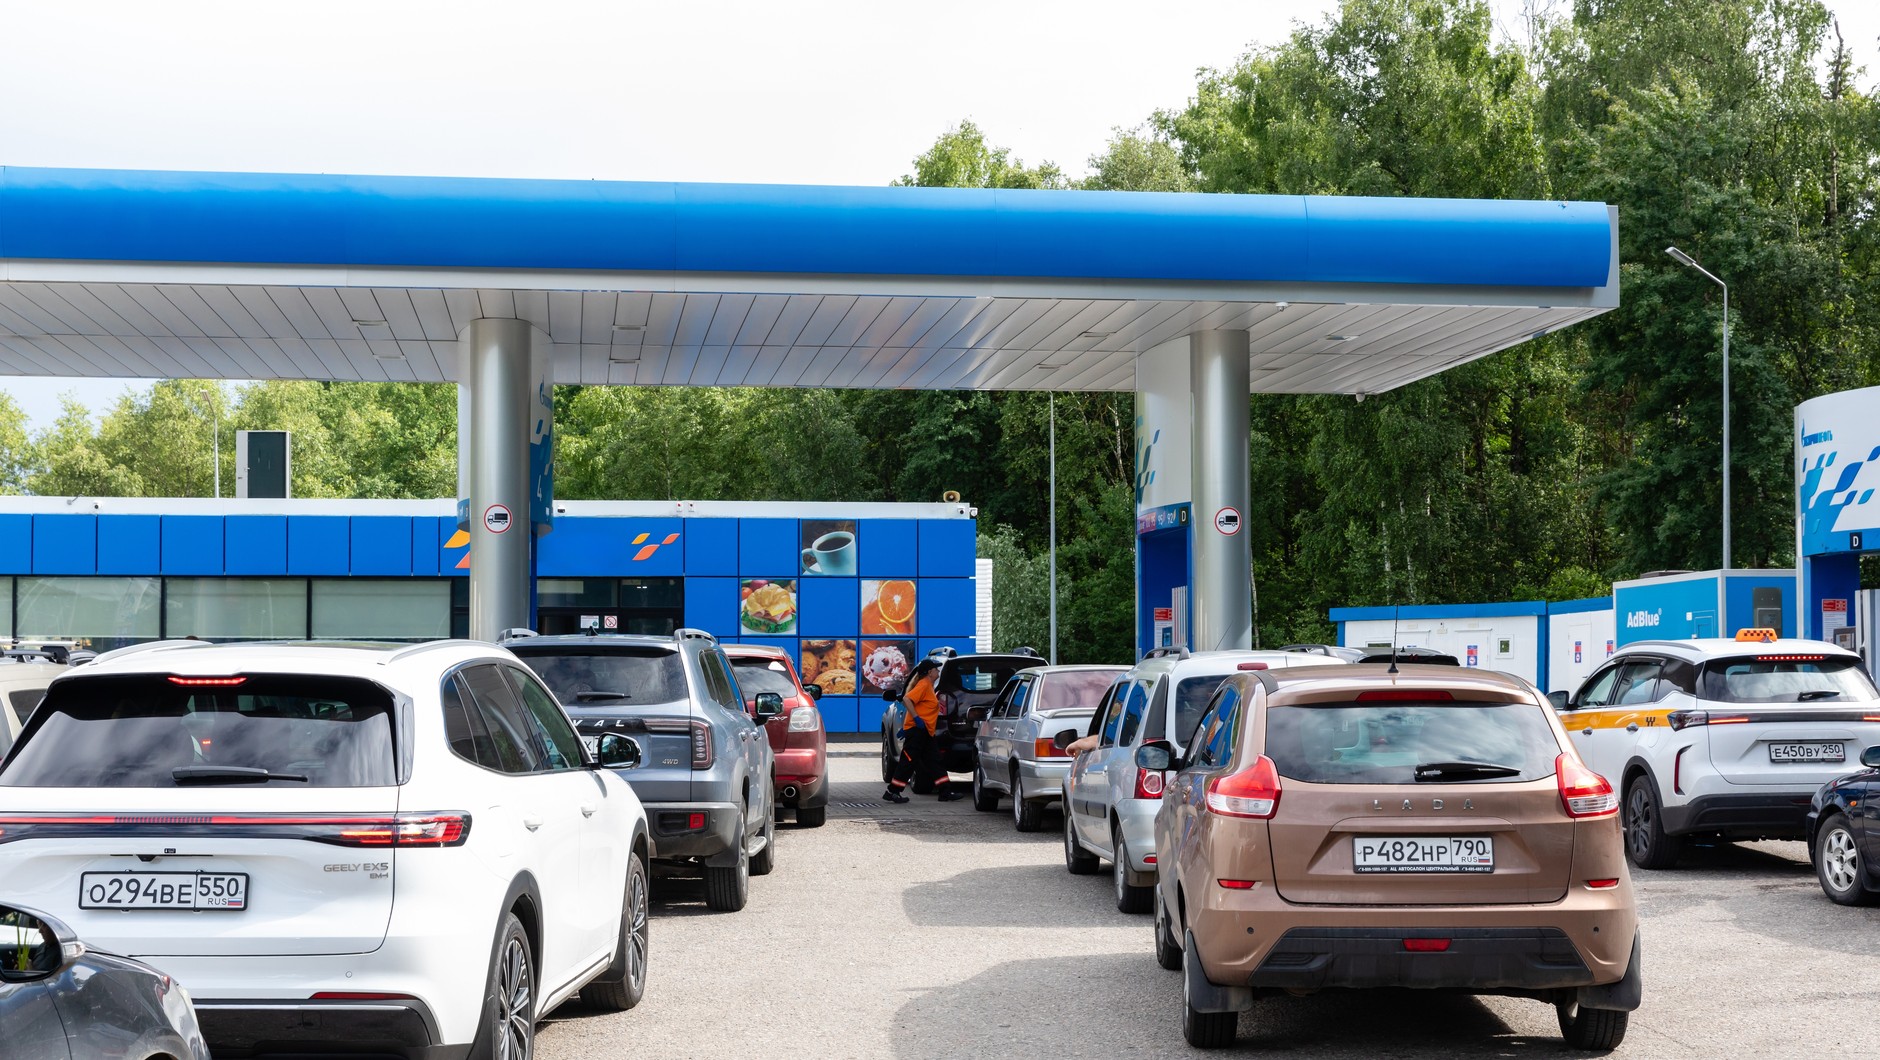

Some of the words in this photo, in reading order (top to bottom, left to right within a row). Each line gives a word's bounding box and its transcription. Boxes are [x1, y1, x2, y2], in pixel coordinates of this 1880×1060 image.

[536, 474, 543, 502] 4
[1181, 510, 1187, 522] D
[1852, 535, 1859, 547] D
[1774, 745, 1820, 757] Е450ВУ
[1822, 744, 1840, 754] 250
[1373, 798, 1475, 810] LADA
[1362, 840, 1448, 862] Р482НР
[1452, 839, 1486, 856] 790
[323, 863, 361, 873] GEELY
[363, 862, 389, 872] EX5
[89, 877, 193, 904] О294ВЕ
[198, 876, 240, 897] 550
[207, 897, 227, 906] RUS
